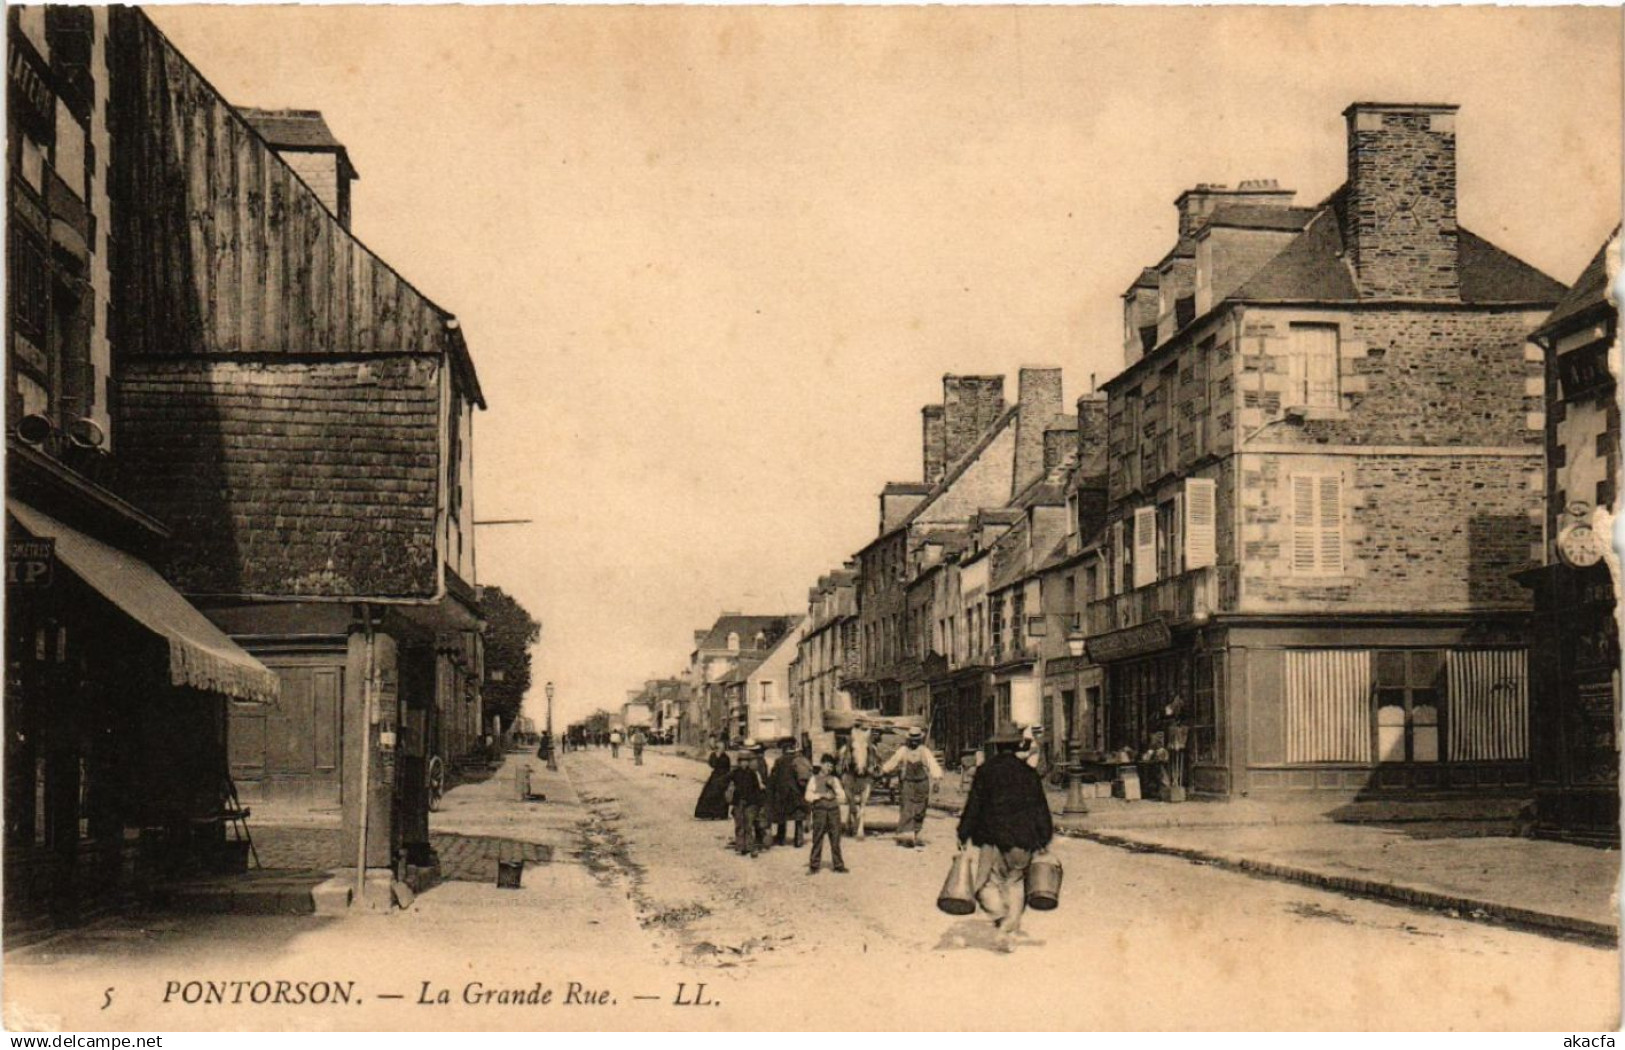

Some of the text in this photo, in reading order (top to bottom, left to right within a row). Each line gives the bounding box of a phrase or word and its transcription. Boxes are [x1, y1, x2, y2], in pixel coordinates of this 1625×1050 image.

[101, 987, 114, 1010] 5
[163, 980, 362, 1005] PONTORSON.
[417, 981, 450, 1005] La
[463, 982, 553, 1005] Grande
[564, 982, 617, 1005] Rue.
[674, 982, 720, 1006] LL.
